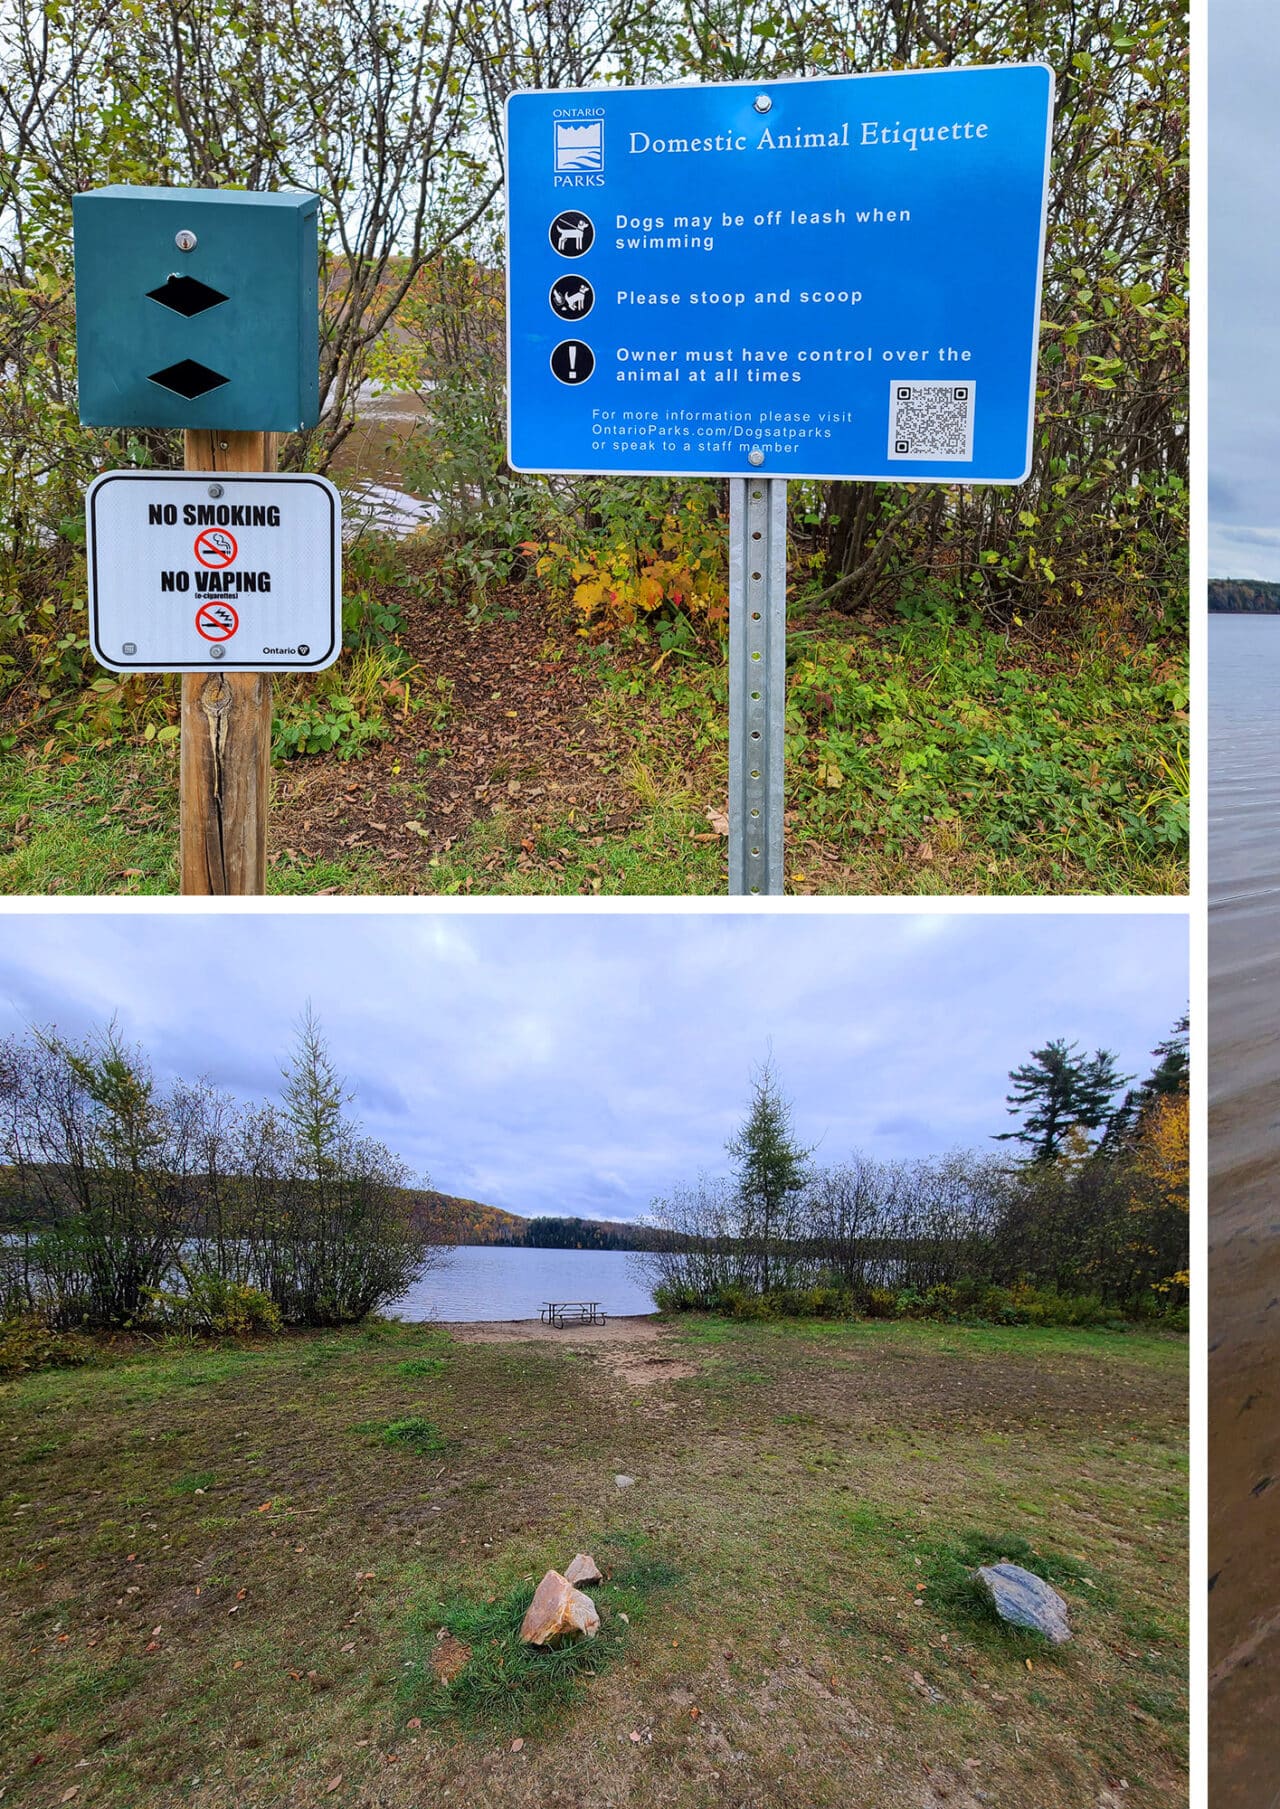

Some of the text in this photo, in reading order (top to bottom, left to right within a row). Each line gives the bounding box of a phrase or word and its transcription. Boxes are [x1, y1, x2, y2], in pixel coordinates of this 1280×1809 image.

[552, 108, 606, 118] ONTARIO
[629, 122, 989, 154] Domestic Animal Etiquette
[553, 175, 605, 188] PARKS
[616, 208, 911, 232] Dogs may be off leash when
[615, 235, 714, 252] swimming
[617, 289, 862, 307] Please stoop and scoop
[616, 348, 972, 362] Owner must have control over the
[616, 369, 801, 383] animal at all times
[592, 409, 852, 424] For more information please visit
[591, 424, 832, 440] OntarioParks.com/Dogsatparks
[591, 441, 606, 450] or
[612, 441, 656, 452] speak
[662, 442, 676, 451] to
[683, 443, 691, 451] a
[698, 441, 732, 452] staff
[149, 504, 280, 526] NO SMOKING
[161, 571, 271, 592] NO VAPING
[263, 646, 296, 655] Ontario
